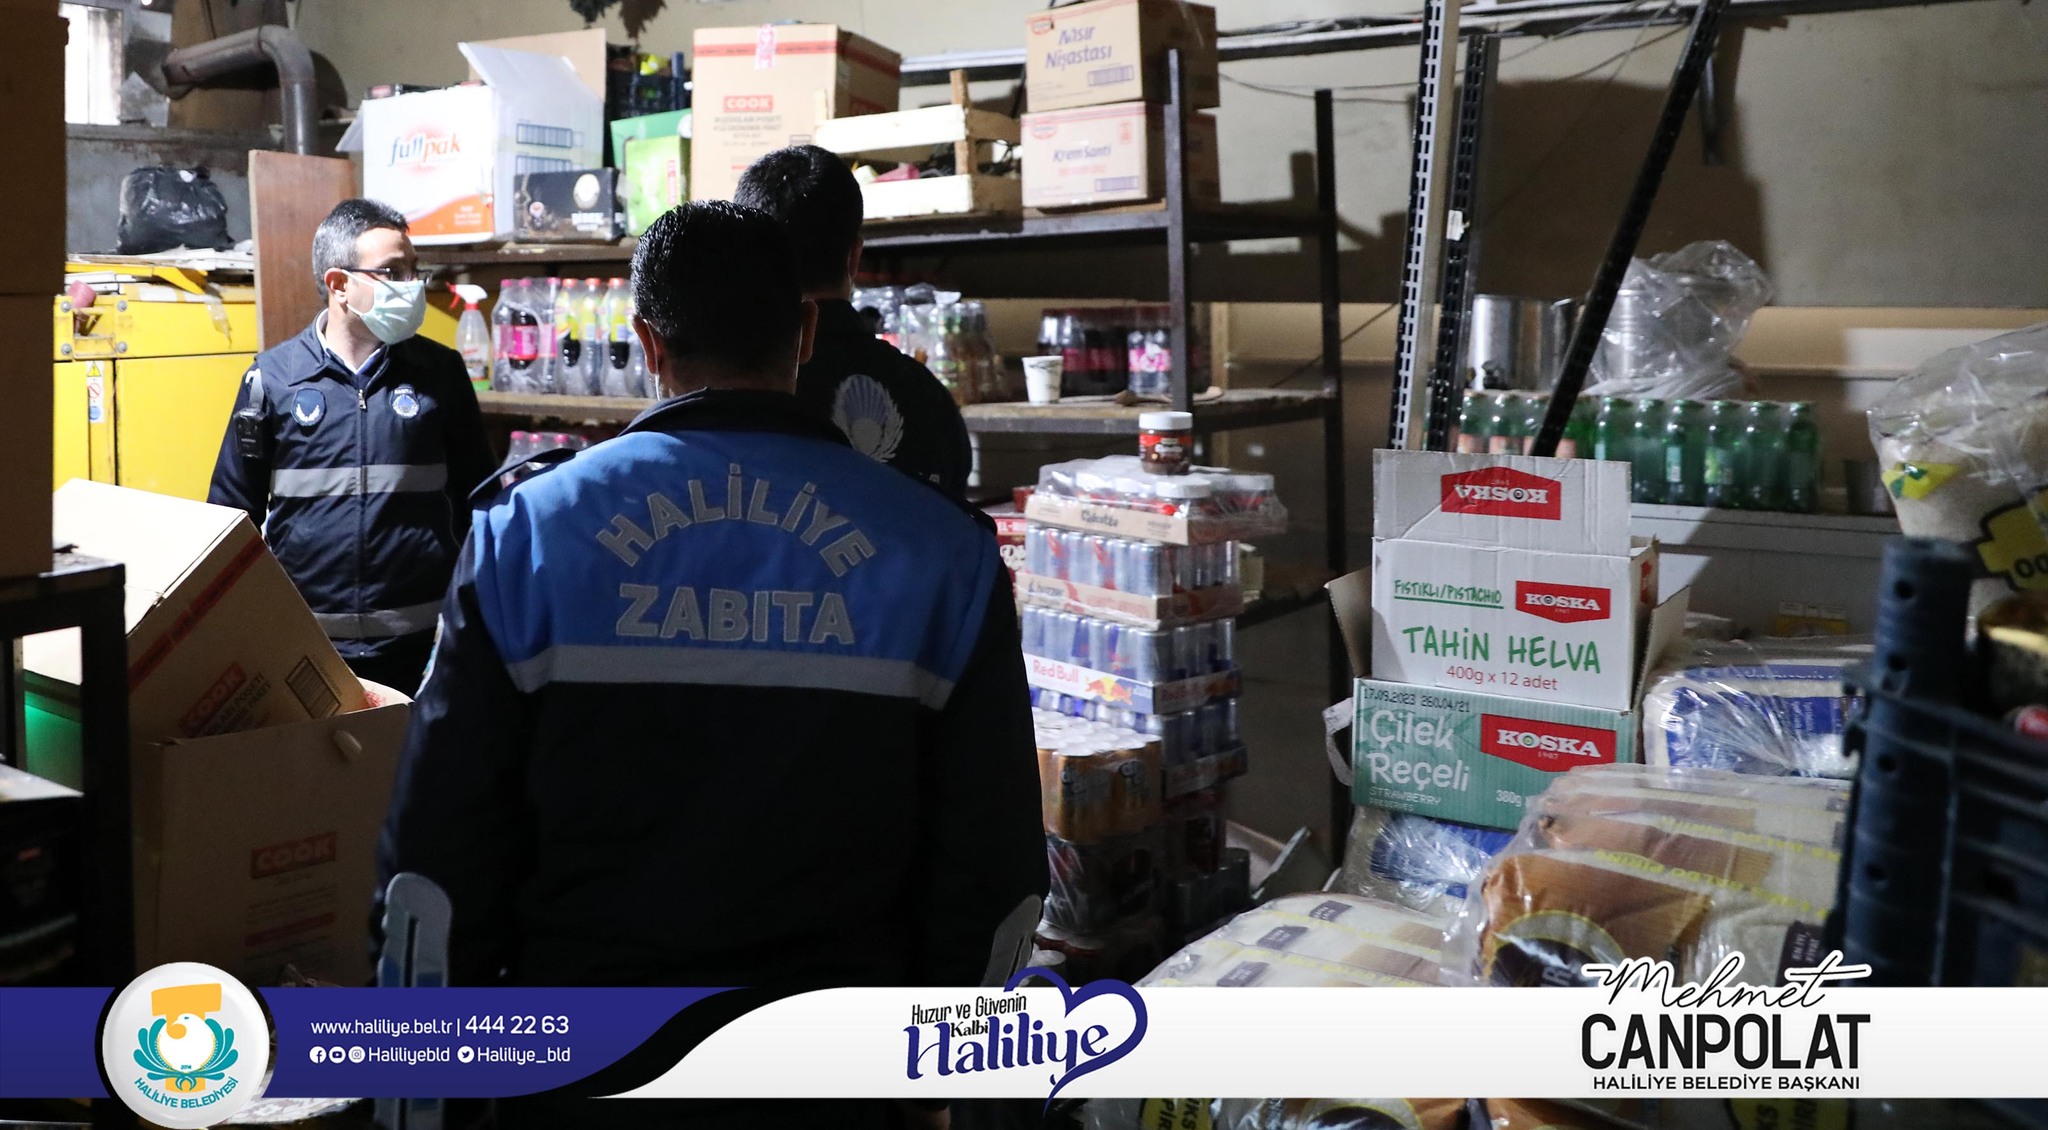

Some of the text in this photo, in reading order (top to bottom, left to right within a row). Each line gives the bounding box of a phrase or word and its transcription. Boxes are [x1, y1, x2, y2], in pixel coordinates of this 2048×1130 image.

[1045, 45, 1113, 71] Nişastası
[726, 96, 772, 110] COOK
[388, 133, 461, 167] fullpak
[1454, 483, 1548, 503] KOSKA
[595, 462, 876, 577] HALİLİYE
[616, 582, 855, 644] ZABITA
[1525, 592, 1601, 611] KOSKA
[1508, 635, 1601, 674] HELVA
[1033, 658, 1079, 684] Red Bull
[1447, 665, 1559, 691] 400g x 12 adet
[1370, 709, 1454, 751] Çilek
[1496, 729, 1602, 758] KOSKA
[1366, 752, 1471, 792] Reçeli
[1369, 786, 1442, 806] STRAWBERRY
